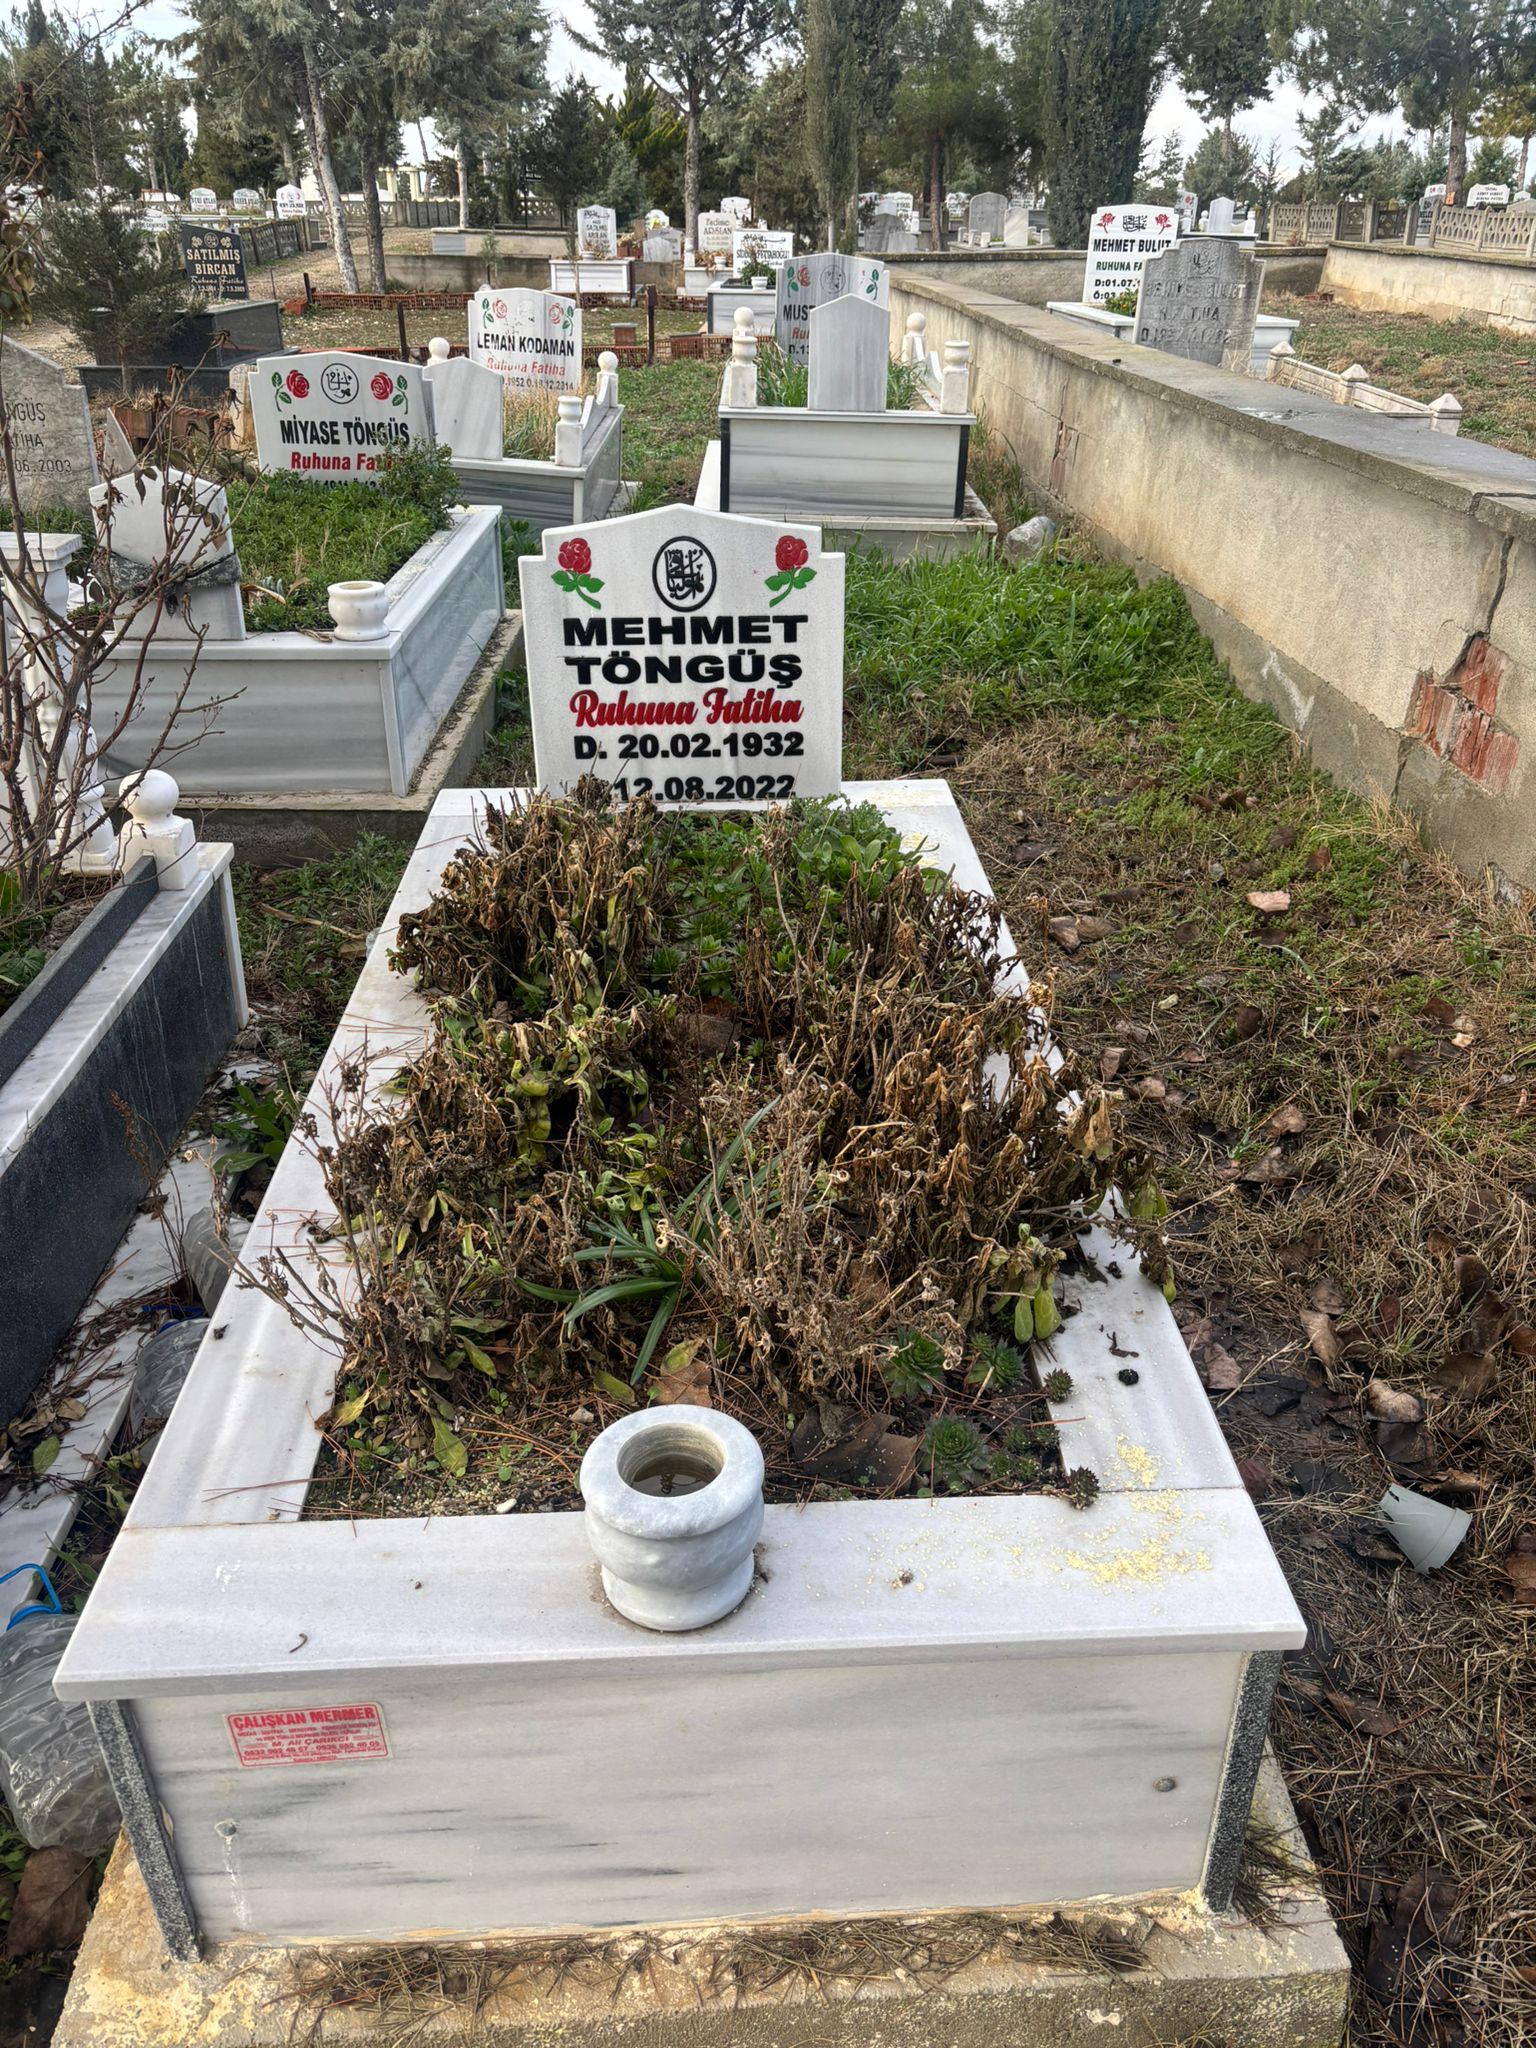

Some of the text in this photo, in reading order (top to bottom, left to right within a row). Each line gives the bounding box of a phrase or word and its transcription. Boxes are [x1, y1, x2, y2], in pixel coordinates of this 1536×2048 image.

[186, 248, 241, 264] SATILMIŞ
[1093, 238, 1135, 252] MEHMET
[194, 260, 236, 275] BİRCAN
[1096, 261, 1131, 271] RUHUNA
[1094, 278, 1140, 288] D:01.07.
[477, 332, 575, 357] LEMAN KODAMAN
[531, 361, 566, 376] Fatiha
[4, 397, 46, 427] NGÜŞ
[280, 414, 341, 445] MİYASE
[290, 451, 351, 470] Ruhuna
[562, 614, 809, 646] MEHMET
[564, 649, 803, 689] TÖNGÜŞ
[568, 687, 805, 728] Ruhuna Fatiha
[573, 732, 805, 760] D. 20.02.1932
[613, 774, 796, 801] 12.08.2022
[232, 1712, 307, 1731] ÇALIŞKAN
[309, 1707, 376, 1723] MERMER
